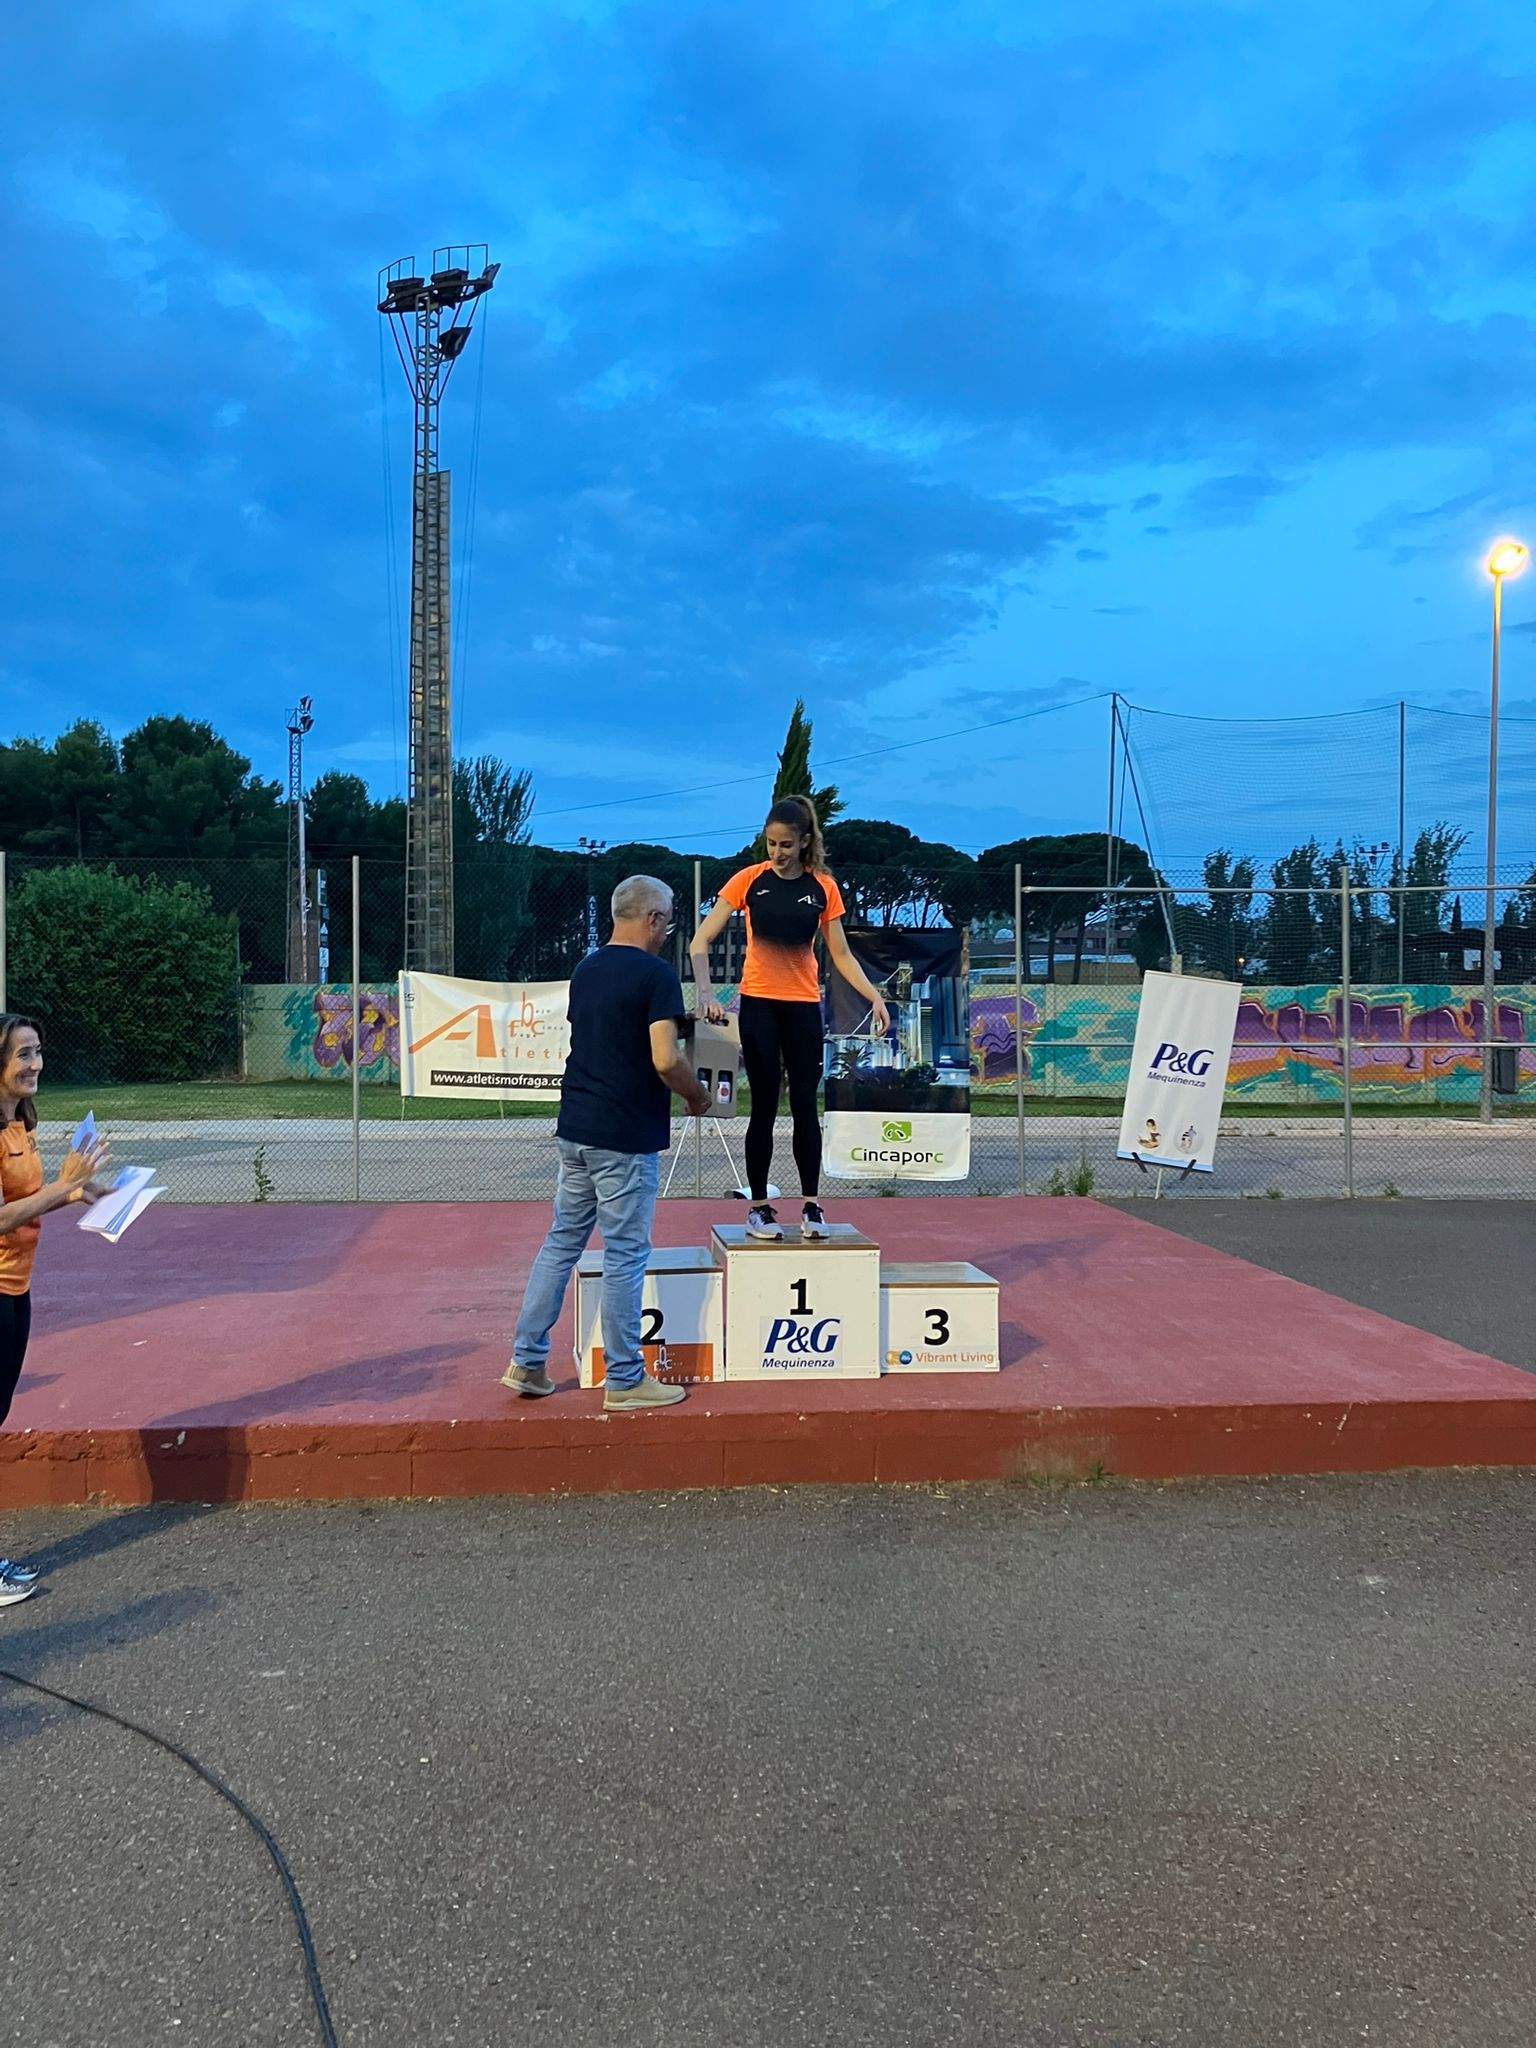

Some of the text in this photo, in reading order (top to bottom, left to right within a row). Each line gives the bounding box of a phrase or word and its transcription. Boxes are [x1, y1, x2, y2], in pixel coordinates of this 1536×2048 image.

[1150, 1043, 1214, 1076] P&G
[1147, 1071, 1206, 1088] Mequinenza
[851, 1147, 944, 1165] Cincaporc
[790, 1279, 813, 1315] 1
[641, 1308, 665, 1345] 2
[764, 1319, 840, 1353] P&G
[924, 1308, 950, 1346] 3
[762, 1358, 835, 1369] Mequinenza
[916, 1353, 956, 1363] Vibrant
[961, 1353, 994, 1364] Living
